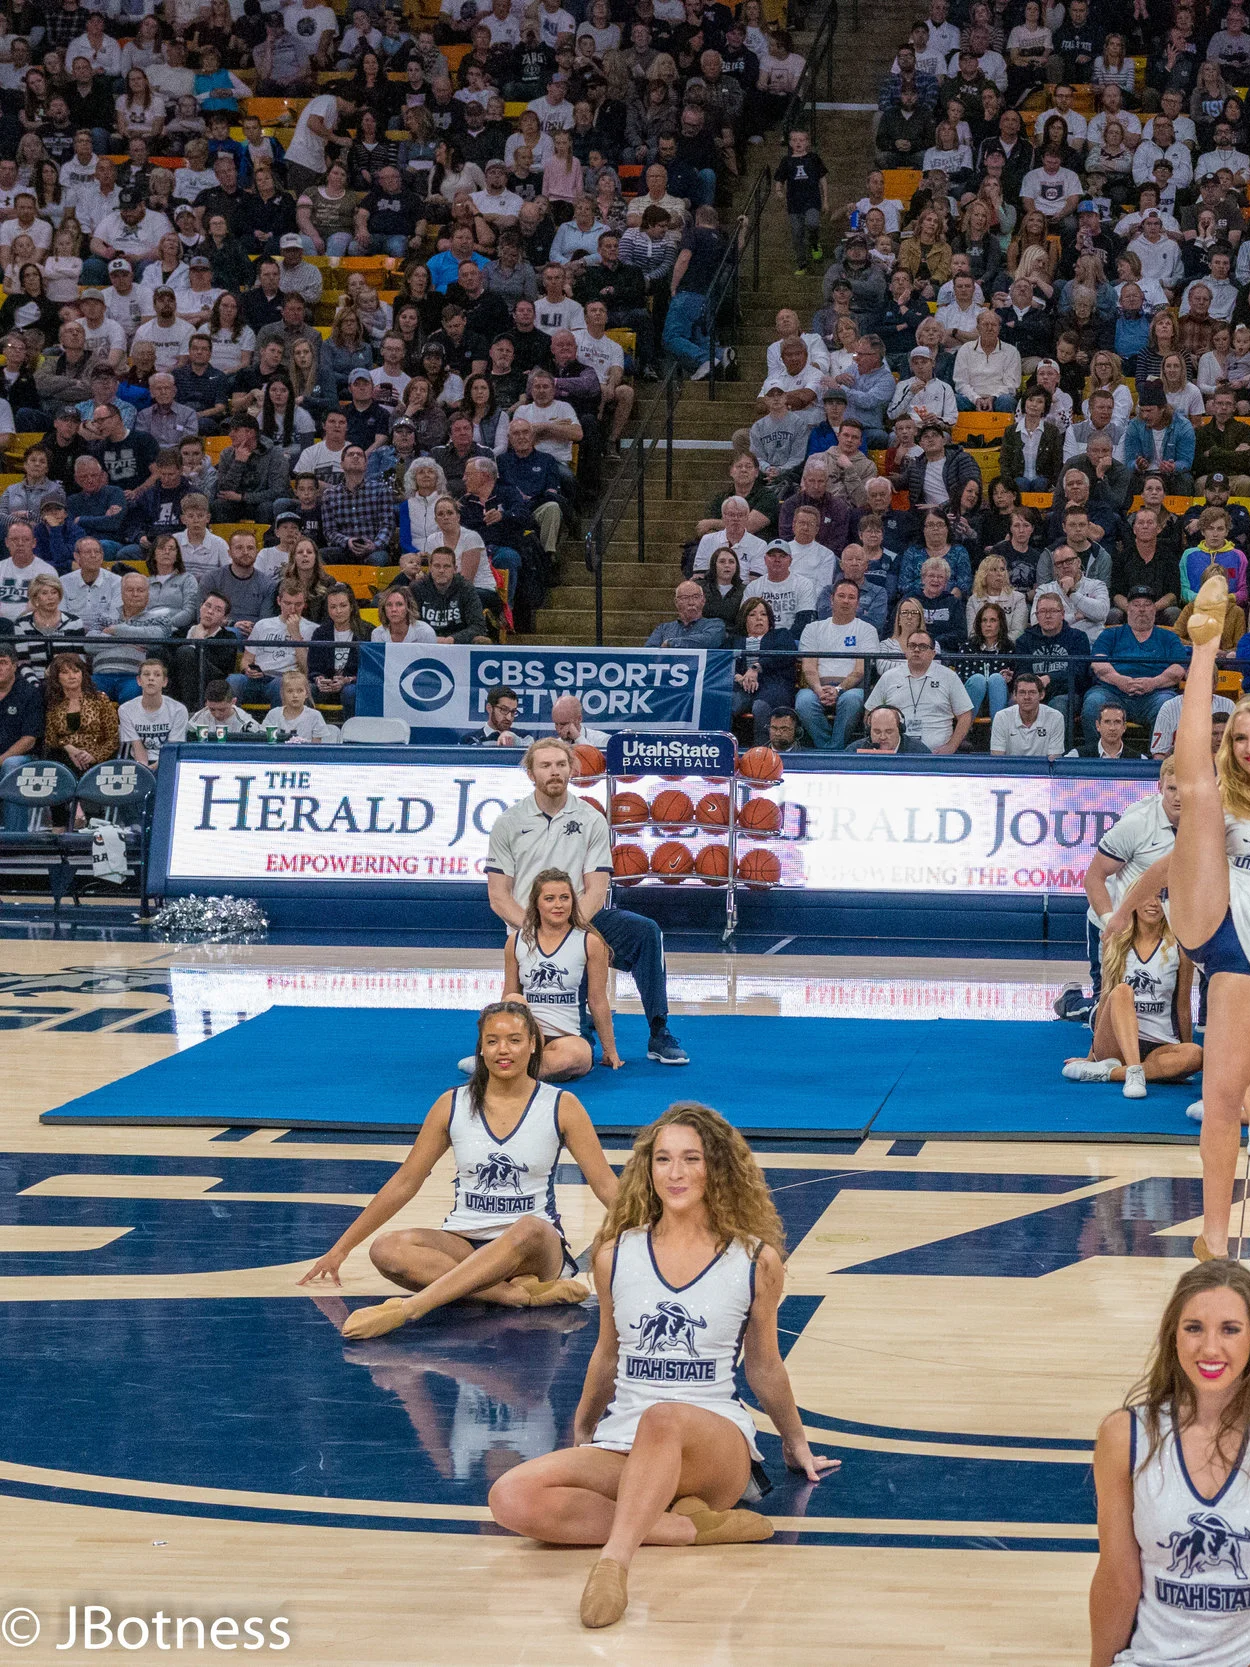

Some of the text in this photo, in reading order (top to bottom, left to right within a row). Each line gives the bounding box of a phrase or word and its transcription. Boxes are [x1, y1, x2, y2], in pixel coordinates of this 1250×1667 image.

[0, 585, 28, 596] STAT
[478, 660, 690, 688] CBS SPORTS
[152, 723, 170, 732] STATE
[1152, 732, 1162, 748] 7
[622, 741, 720, 757] UtahState
[622, 757, 720, 768] BASKETBALL
[16, 776, 58, 787] STATE
[96, 774, 138, 786] STATE
[265, 771, 311, 789] THE
[194, 774, 435, 834] HERALD
[265, 854, 418, 875] EMPOWERING
[426, 856, 468, 876] THE
[966, 866, 1008, 886] THE
[525, 992, 576, 1005] UTAH STATE
[1139, 1000, 1166, 1013] STATE
[464, 1193, 536, 1214] UTAH STATE
[626, 1356, 716, 1383] UTAH STATE
[1154, 1577, 1206, 1611] UTAH
